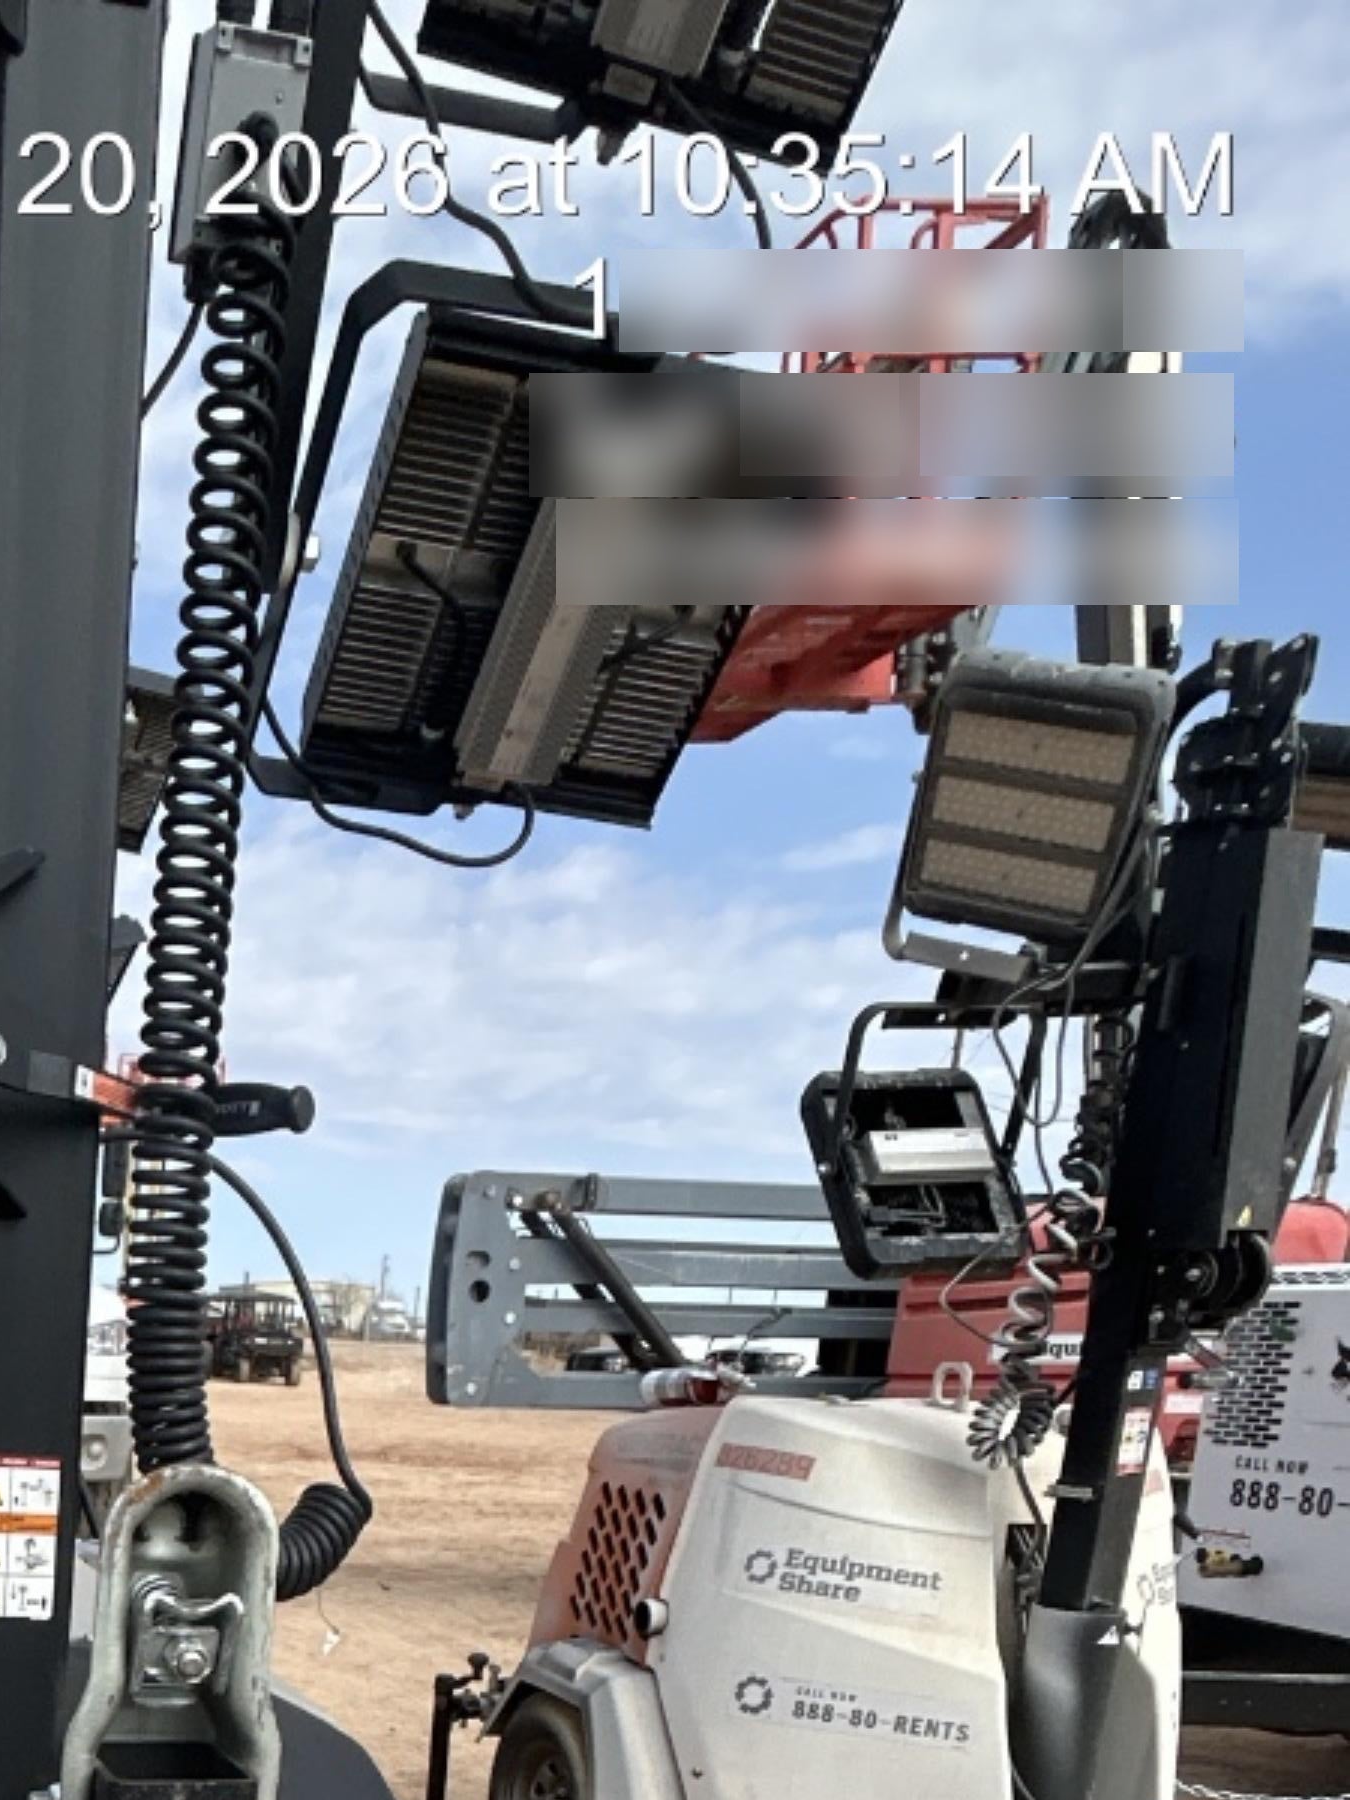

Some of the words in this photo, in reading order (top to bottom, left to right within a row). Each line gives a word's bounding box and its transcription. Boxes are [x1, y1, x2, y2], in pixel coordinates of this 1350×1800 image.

[1234, 1455, 1271, 1471] CALL
[778, 1571, 861, 1602] Share
[783, 1548, 943, 1591] Equipment
[792, 1700, 971, 1743] 888-80-RENTS
